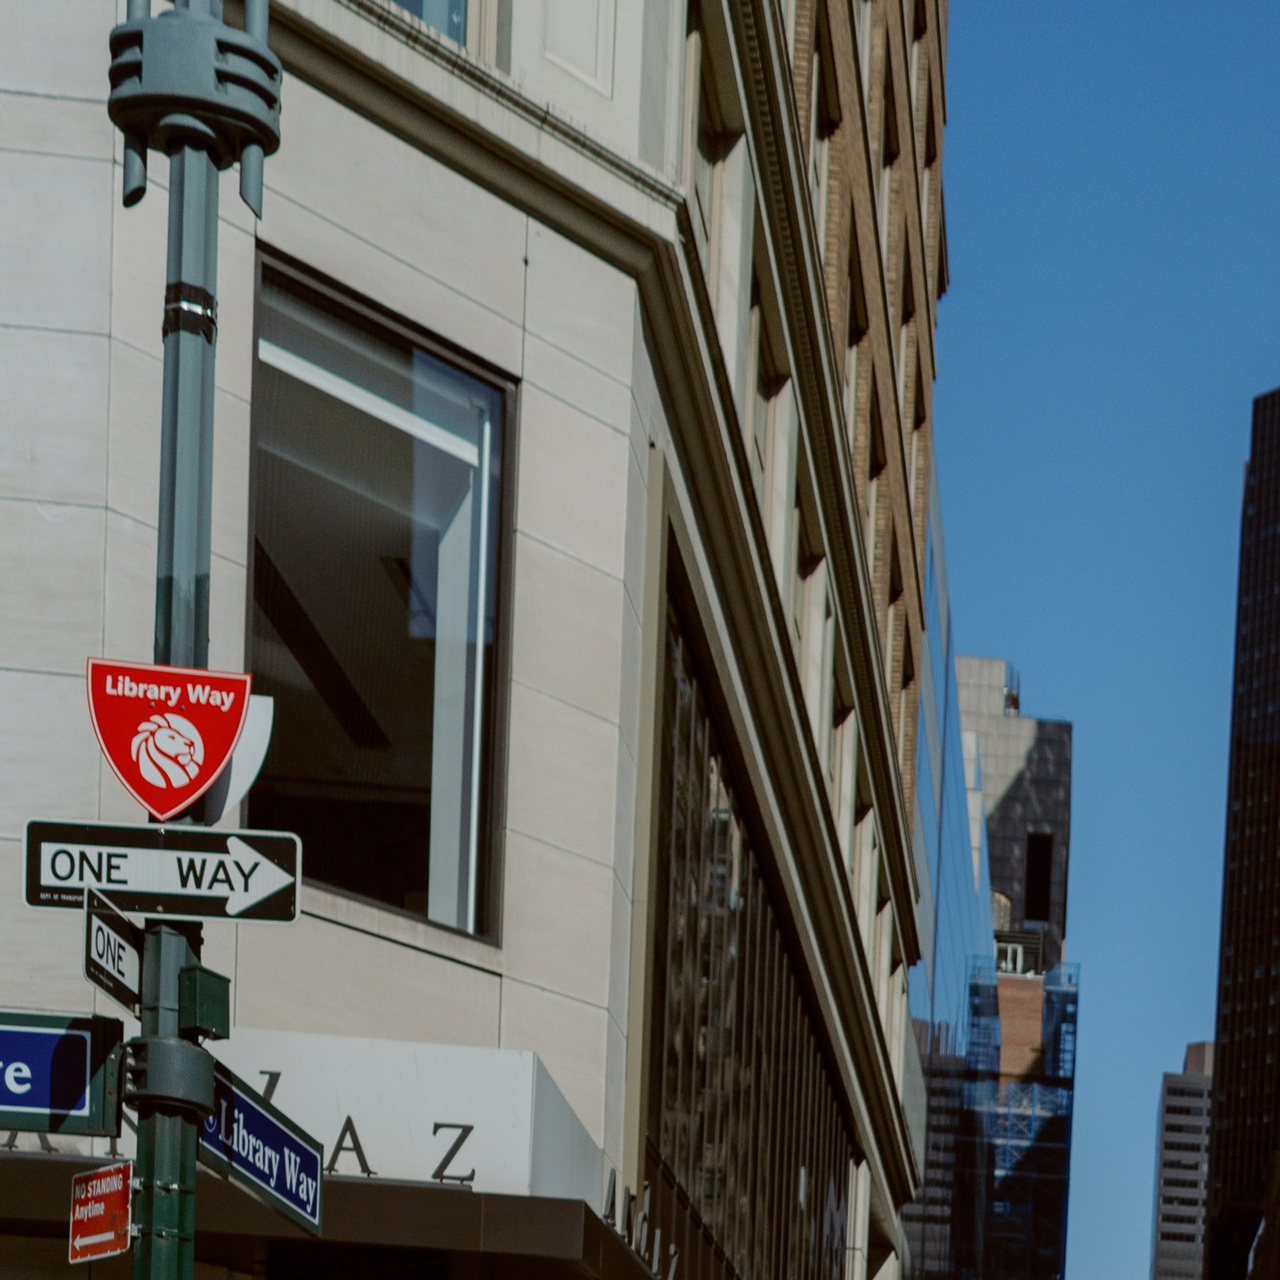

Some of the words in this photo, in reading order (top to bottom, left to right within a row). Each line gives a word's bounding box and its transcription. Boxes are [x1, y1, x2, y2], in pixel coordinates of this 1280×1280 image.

[106, 675, 181, 707] Library
[187, 683, 235, 712] Way
[51, 849, 128, 885] ONE
[177, 856, 260, 893] WAY
[95, 925, 126, 978] ONE
[0, 1061, 32, 1095] e
[218, 1098, 280, 1182] Library
[283, 1146, 316, 1213] Way
[75, 1182, 86, 1200] NO
[87, 1173, 123, 1198] STANDING
[74, 1200, 105, 1222] Anytime
